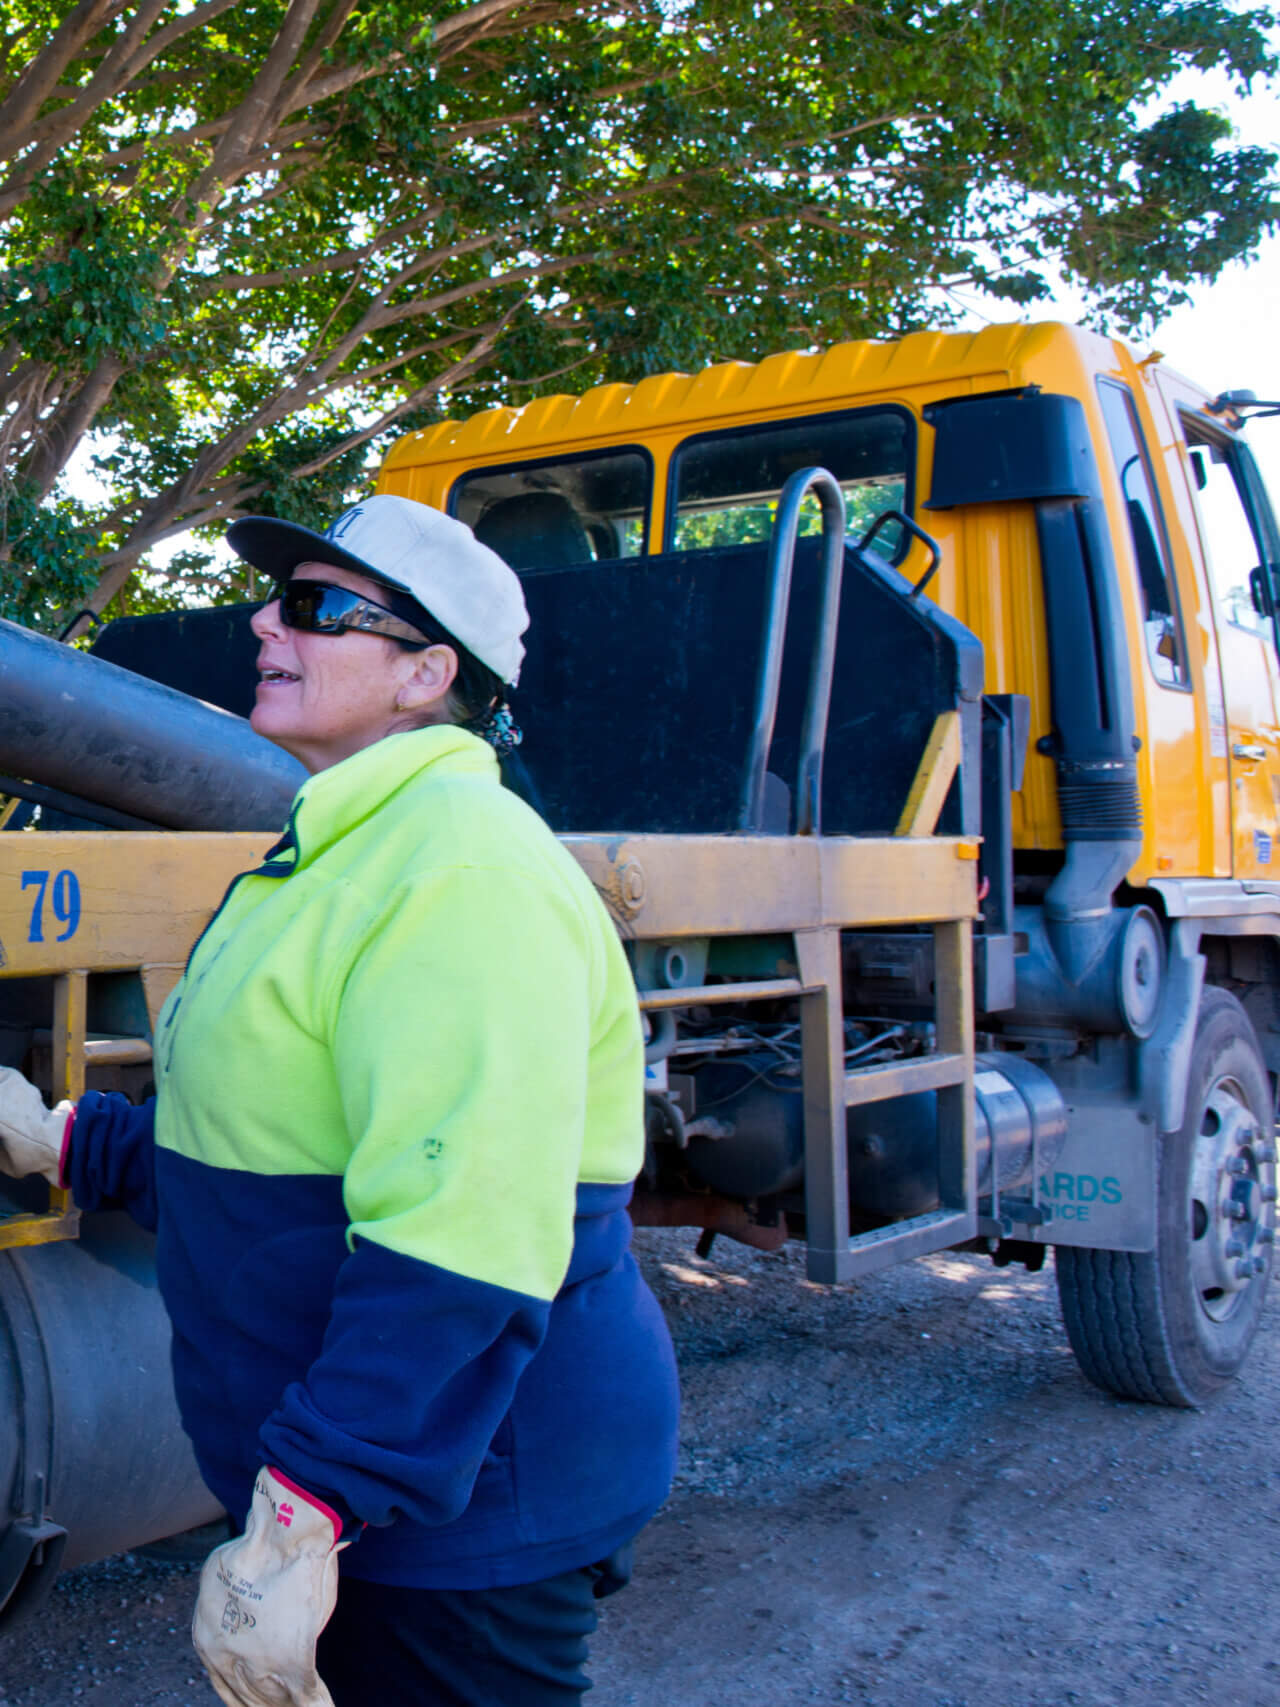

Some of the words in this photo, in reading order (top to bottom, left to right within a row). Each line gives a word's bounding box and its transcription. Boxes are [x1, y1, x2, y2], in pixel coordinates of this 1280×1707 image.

[21, 869, 81, 943] 79
[1039, 1172, 1123, 1205] ARDS
[1051, 1203, 1090, 1222] ICE
